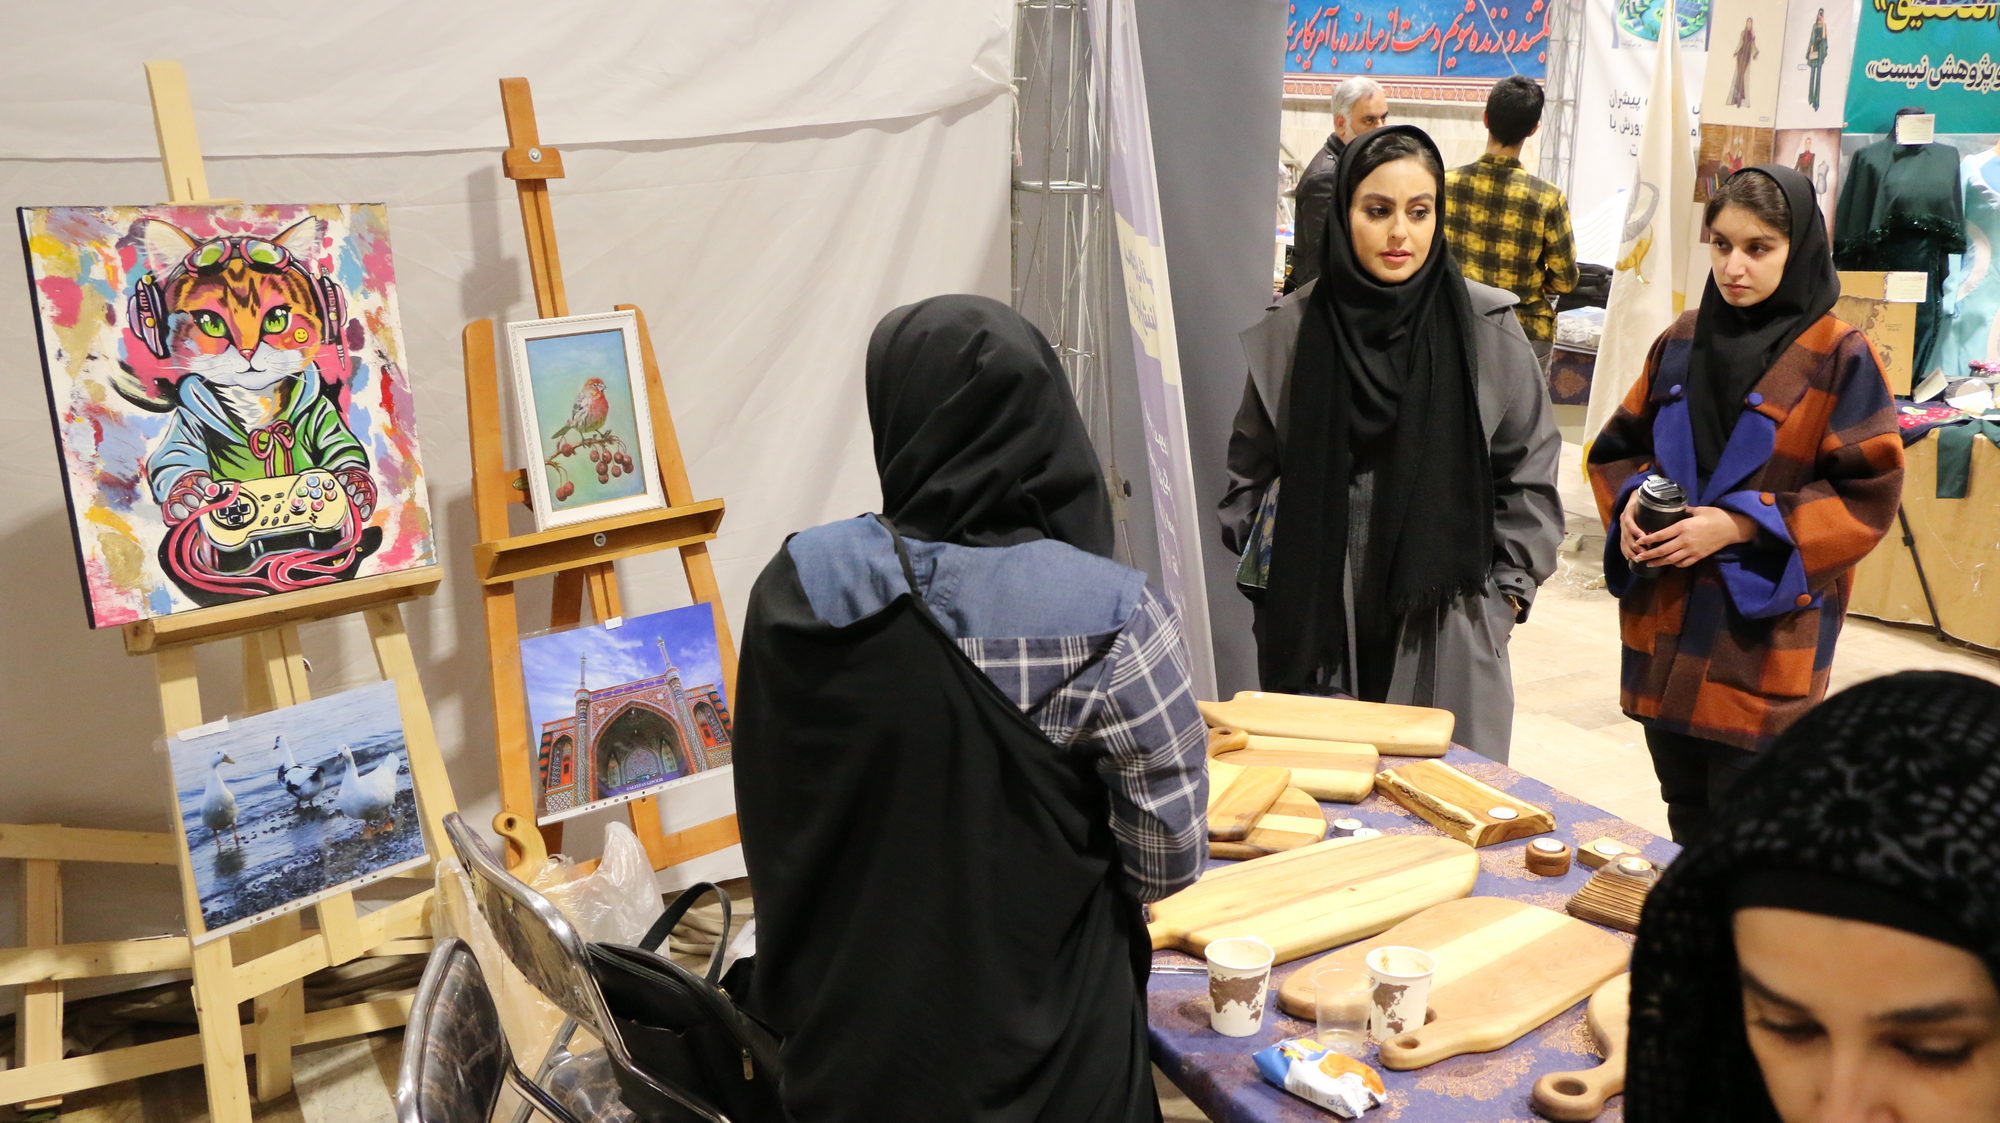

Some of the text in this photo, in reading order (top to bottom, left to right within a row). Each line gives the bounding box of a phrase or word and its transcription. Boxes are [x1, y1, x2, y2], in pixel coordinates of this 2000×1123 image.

[1338, 11, 1386, 70] مبارزه
[1378, 6, 1400, 52] از
[1391, 18, 1441, 52] دست
